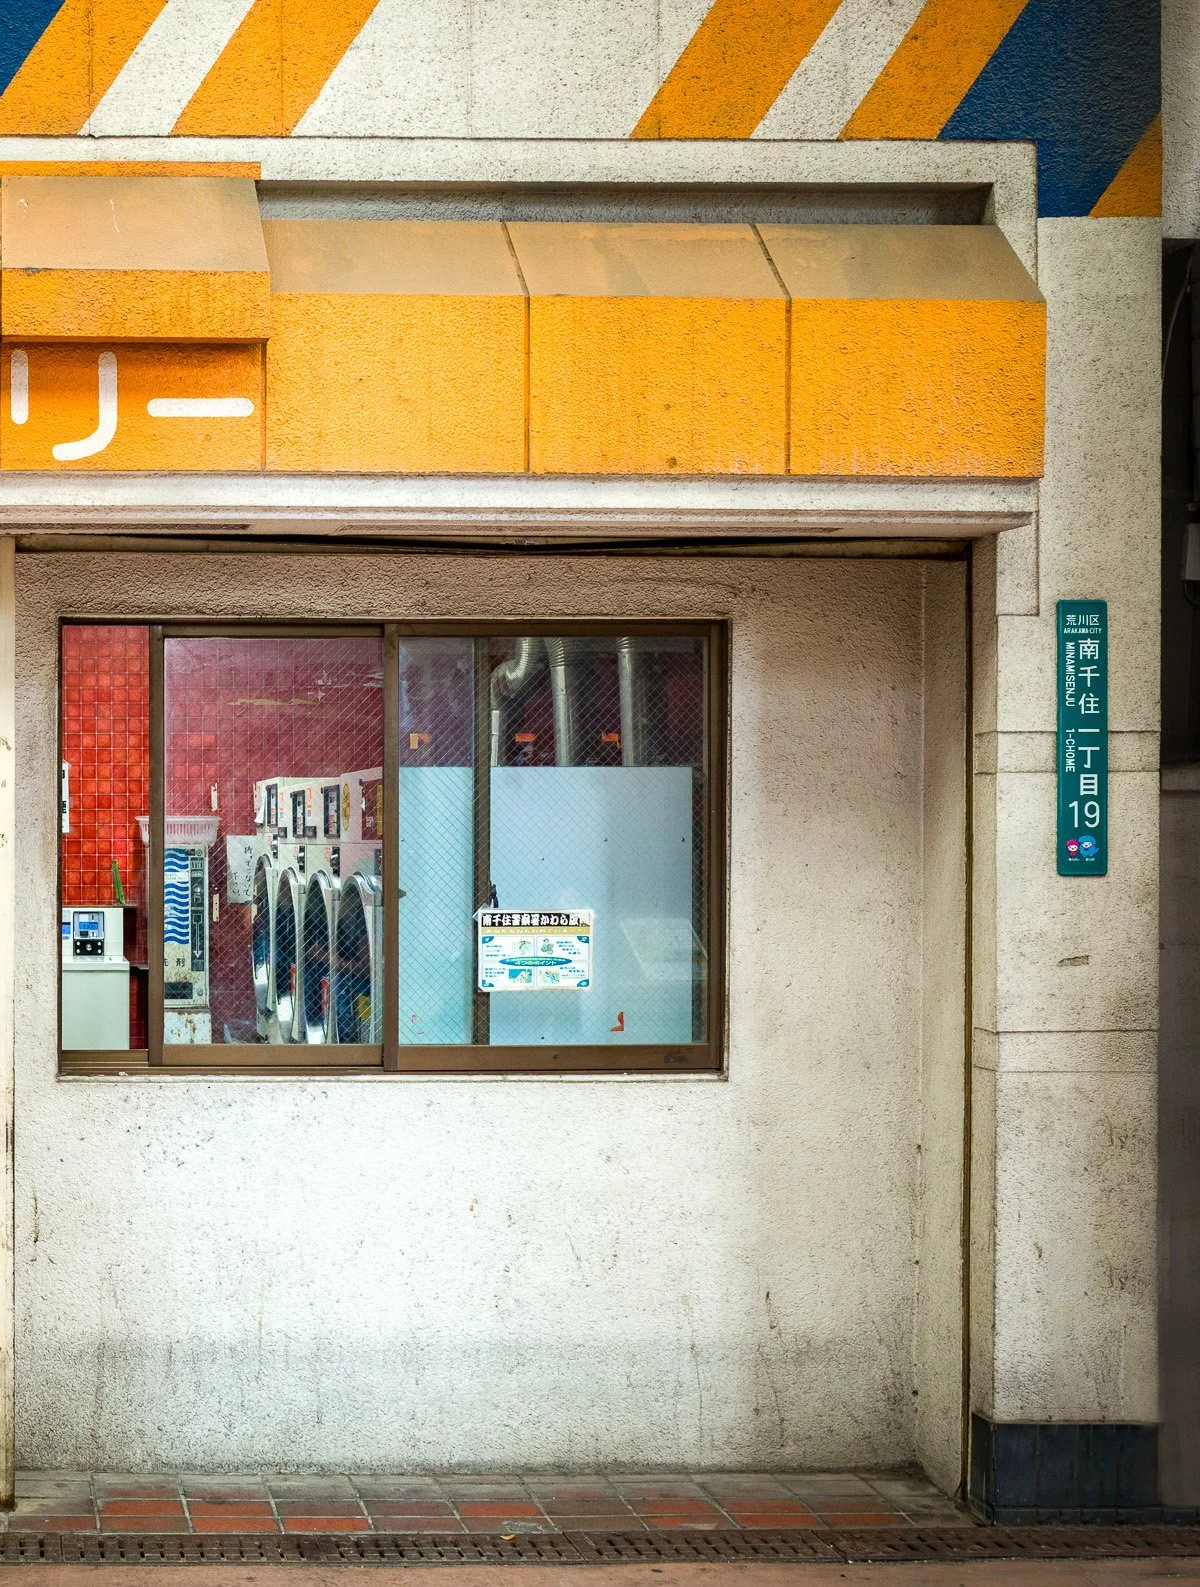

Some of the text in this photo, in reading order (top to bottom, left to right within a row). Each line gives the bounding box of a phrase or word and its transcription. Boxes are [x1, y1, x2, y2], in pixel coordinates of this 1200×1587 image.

[1065, 614, 1100, 626] 荒川区
[1065, 642, 1076, 773] MINAMISENJU 1-CHOME
[1068, 801, 1100, 829] 19
